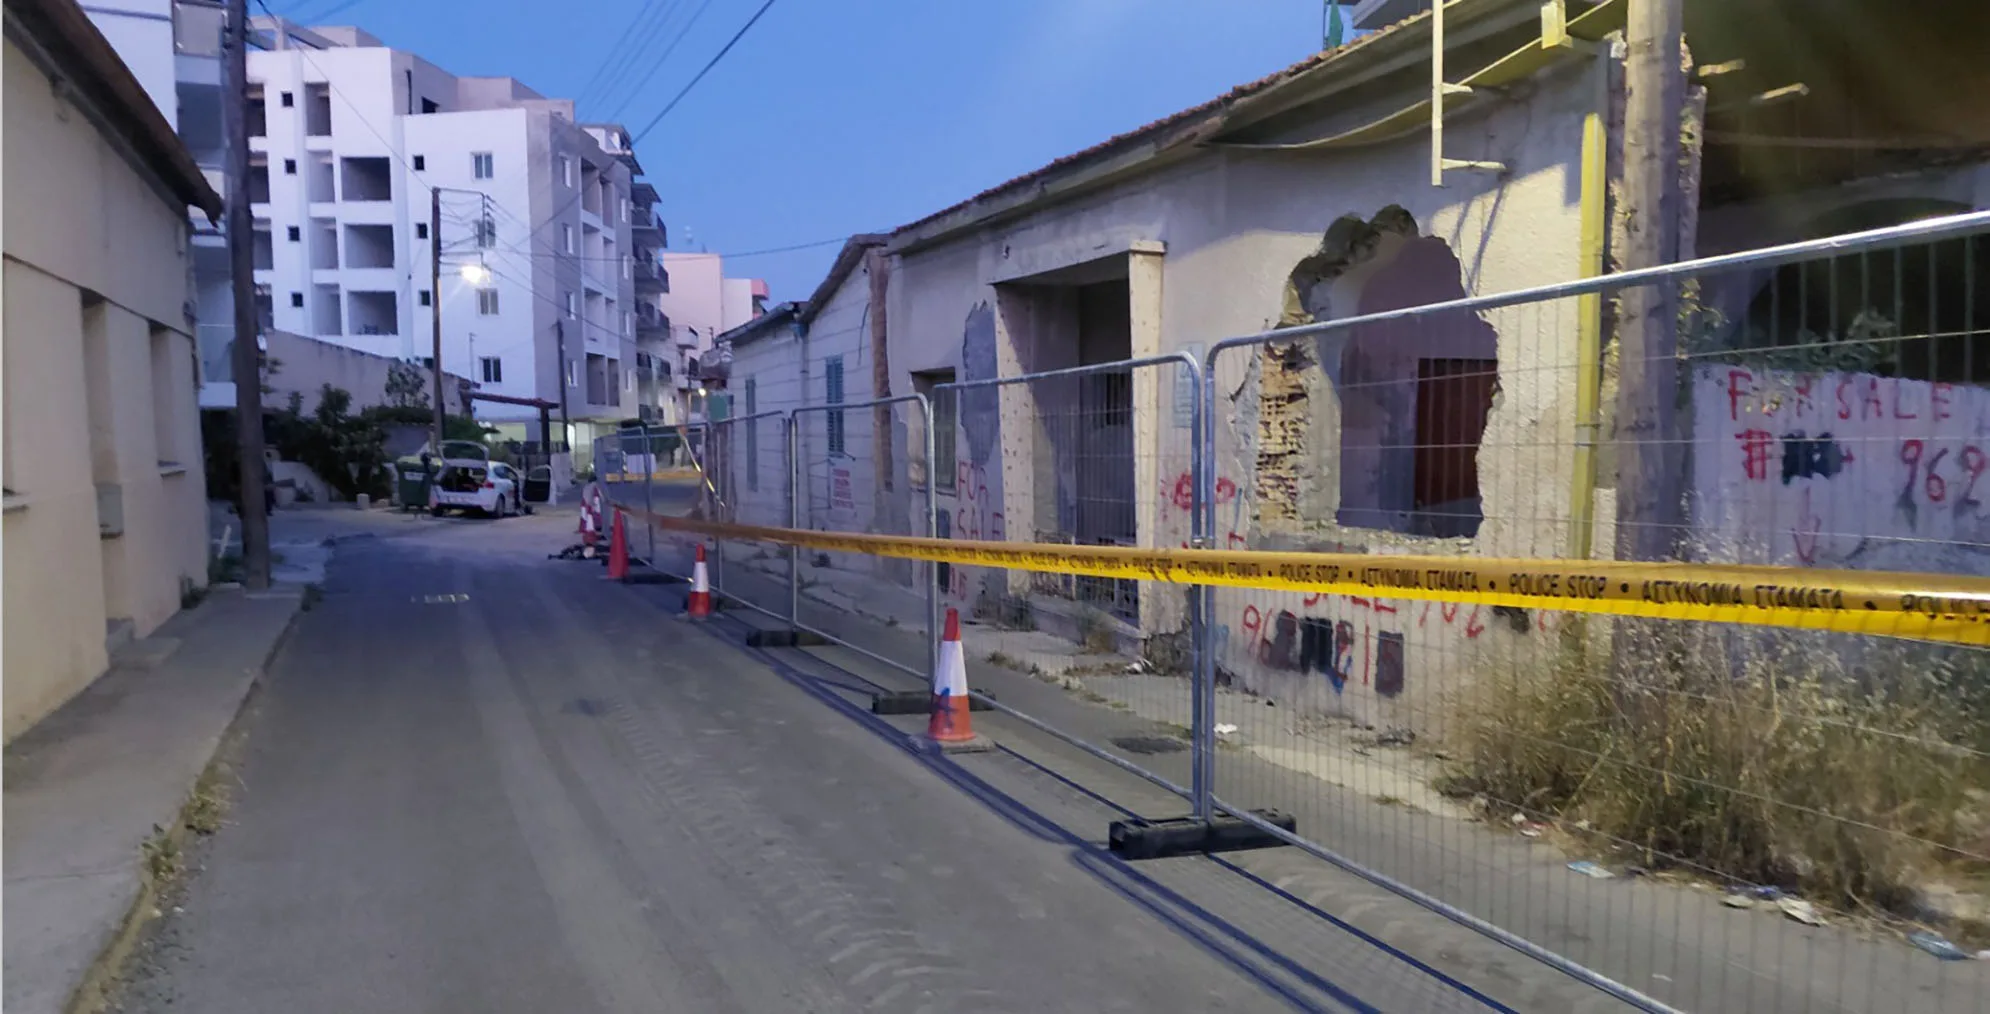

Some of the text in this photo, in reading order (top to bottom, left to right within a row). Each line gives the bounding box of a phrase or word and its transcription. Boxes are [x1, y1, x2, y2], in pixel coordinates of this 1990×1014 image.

[1728, 369, 1952, 422] FR SALE
[1509, 572, 1607, 600] POLICE STOP
